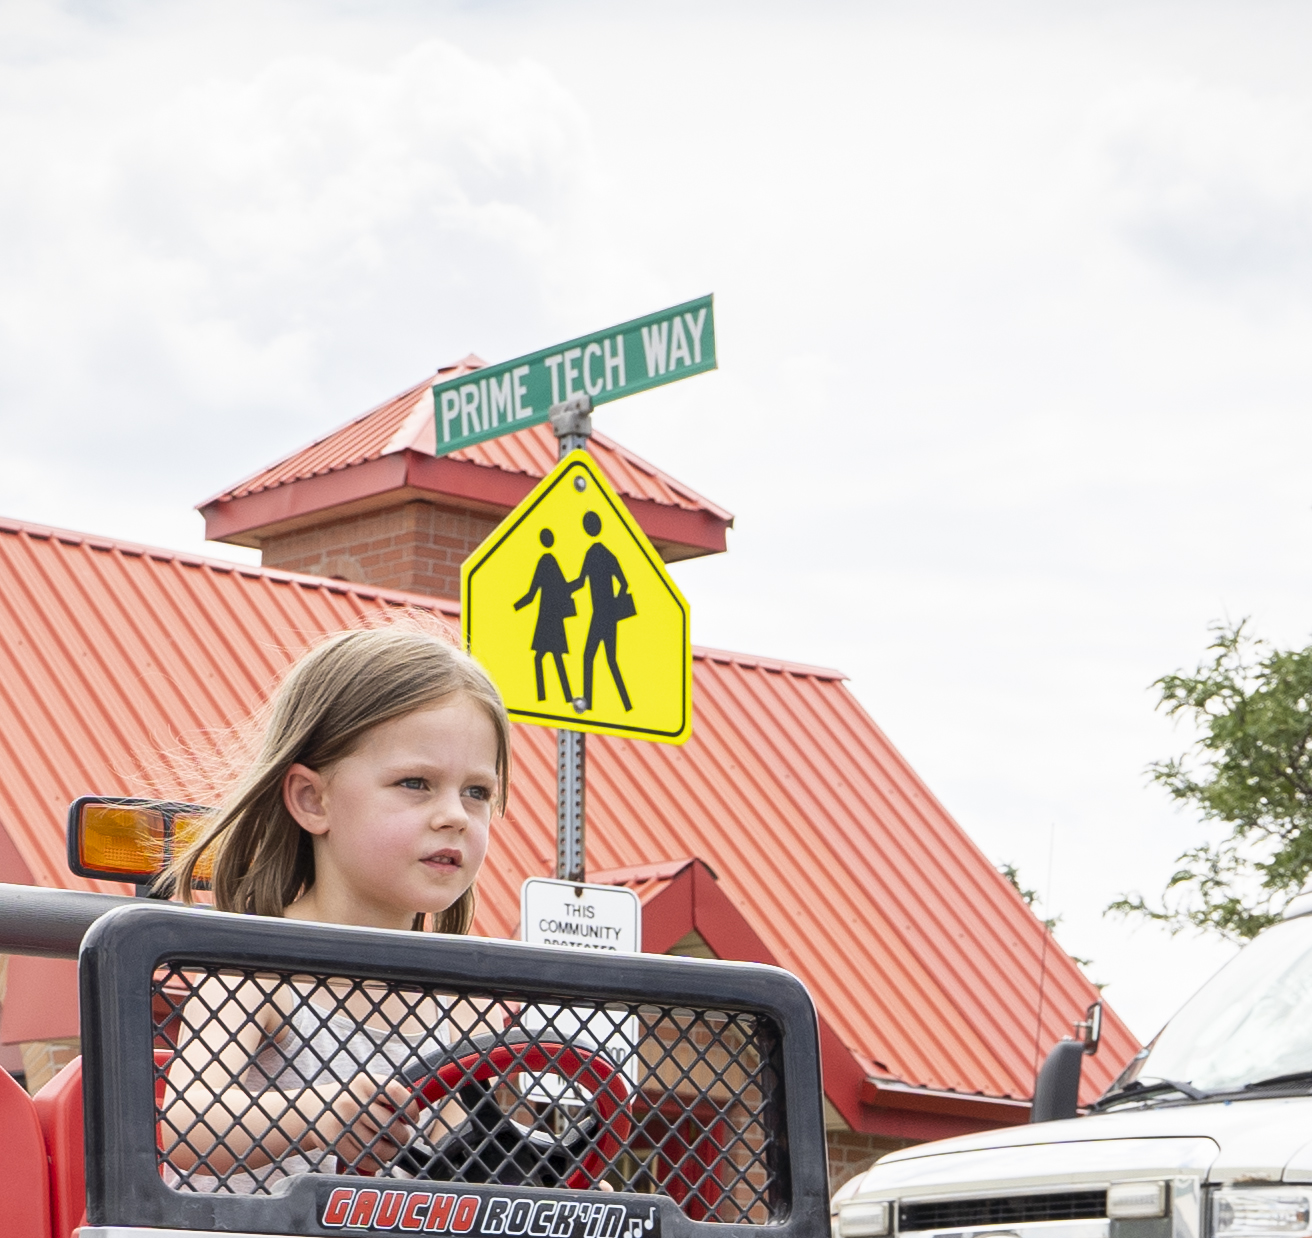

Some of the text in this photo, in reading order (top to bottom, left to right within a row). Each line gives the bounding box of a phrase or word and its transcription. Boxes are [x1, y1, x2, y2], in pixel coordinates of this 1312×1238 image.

[441, 308, 707, 443] PRIME TECH WAY
[564, 903, 595, 919] THIS
[539, 919, 622, 940] COMMUNITY
[322, 1187, 481, 1233] GAUCHO
